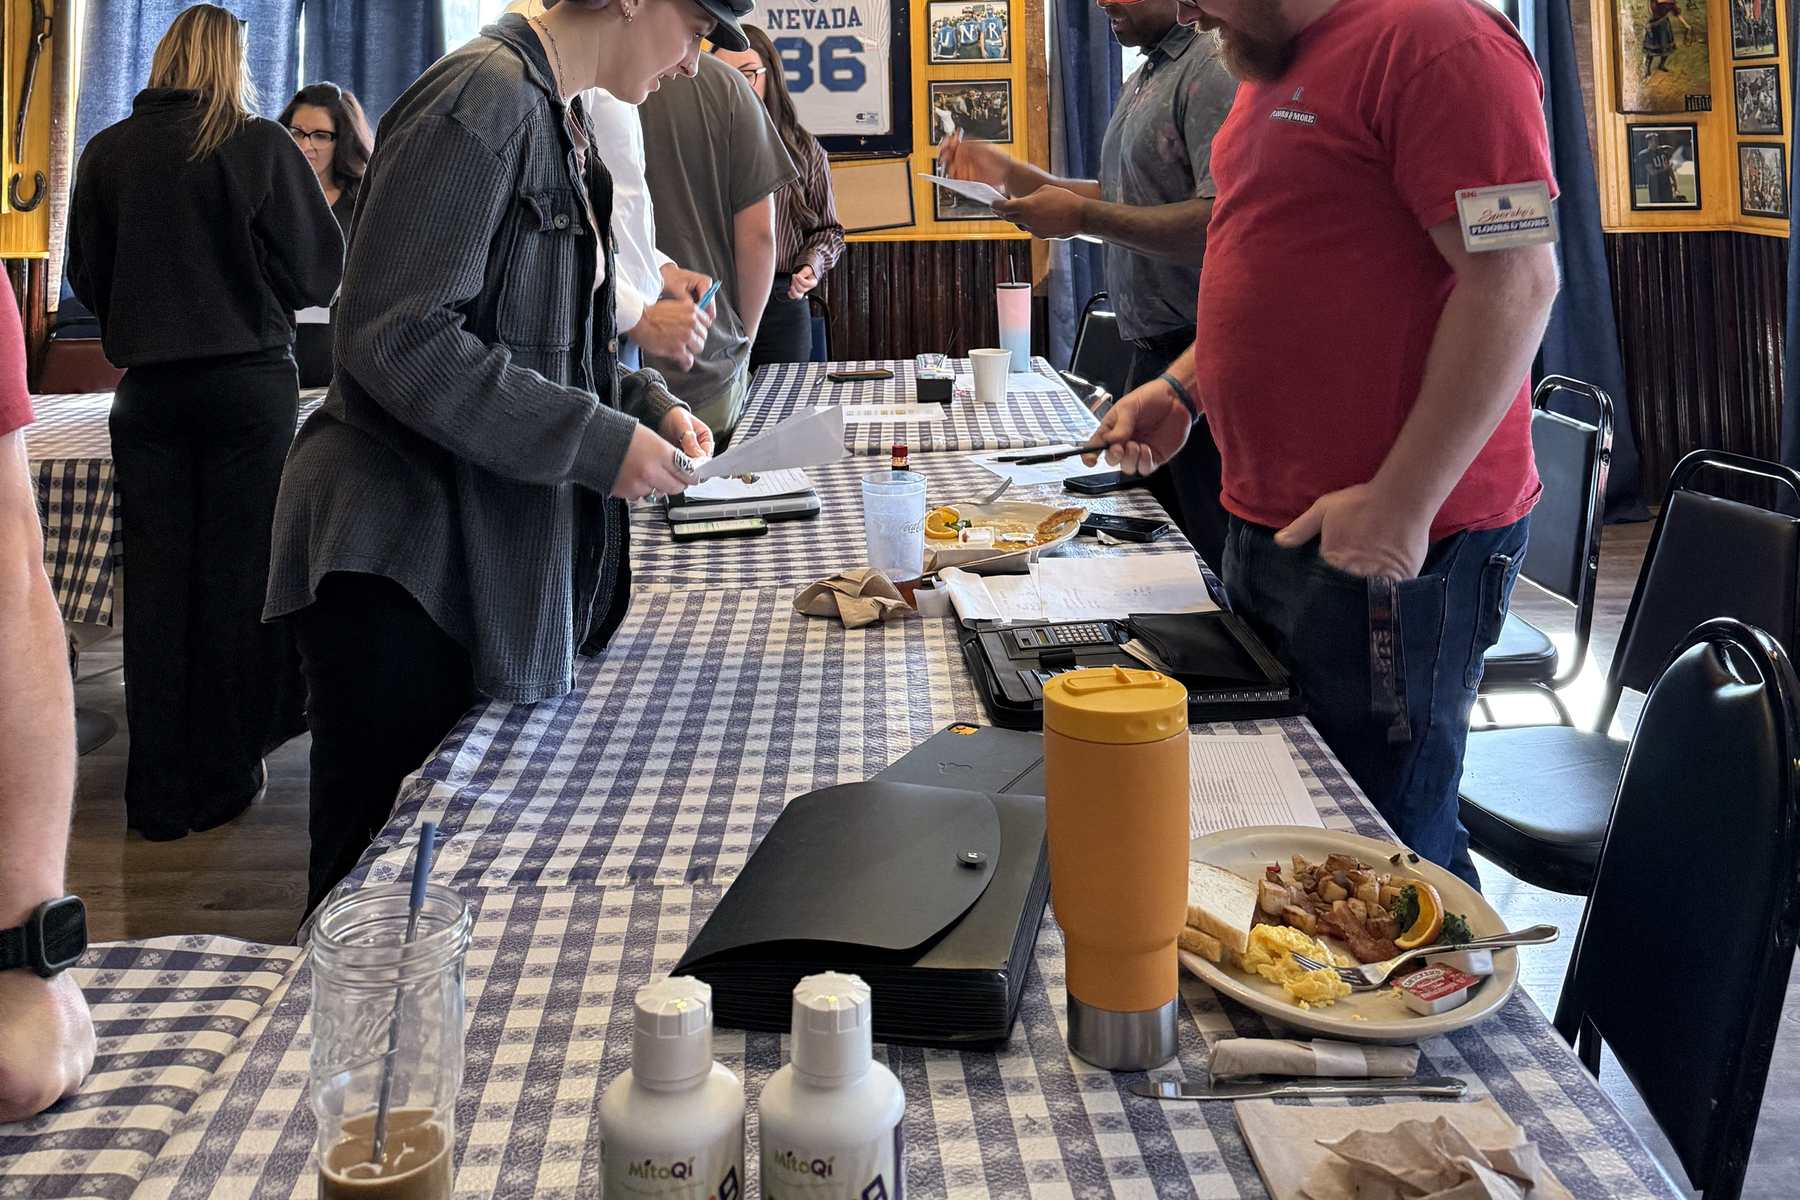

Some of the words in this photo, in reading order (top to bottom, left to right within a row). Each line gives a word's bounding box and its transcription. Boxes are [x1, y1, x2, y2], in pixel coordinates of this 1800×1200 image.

[767, 5, 863, 30] NEVADA
[773, 35, 867, 93] 86
[627, 1155, 696, 1180] MitoQi
[774, 1149, 835, 1178] MitoQi
